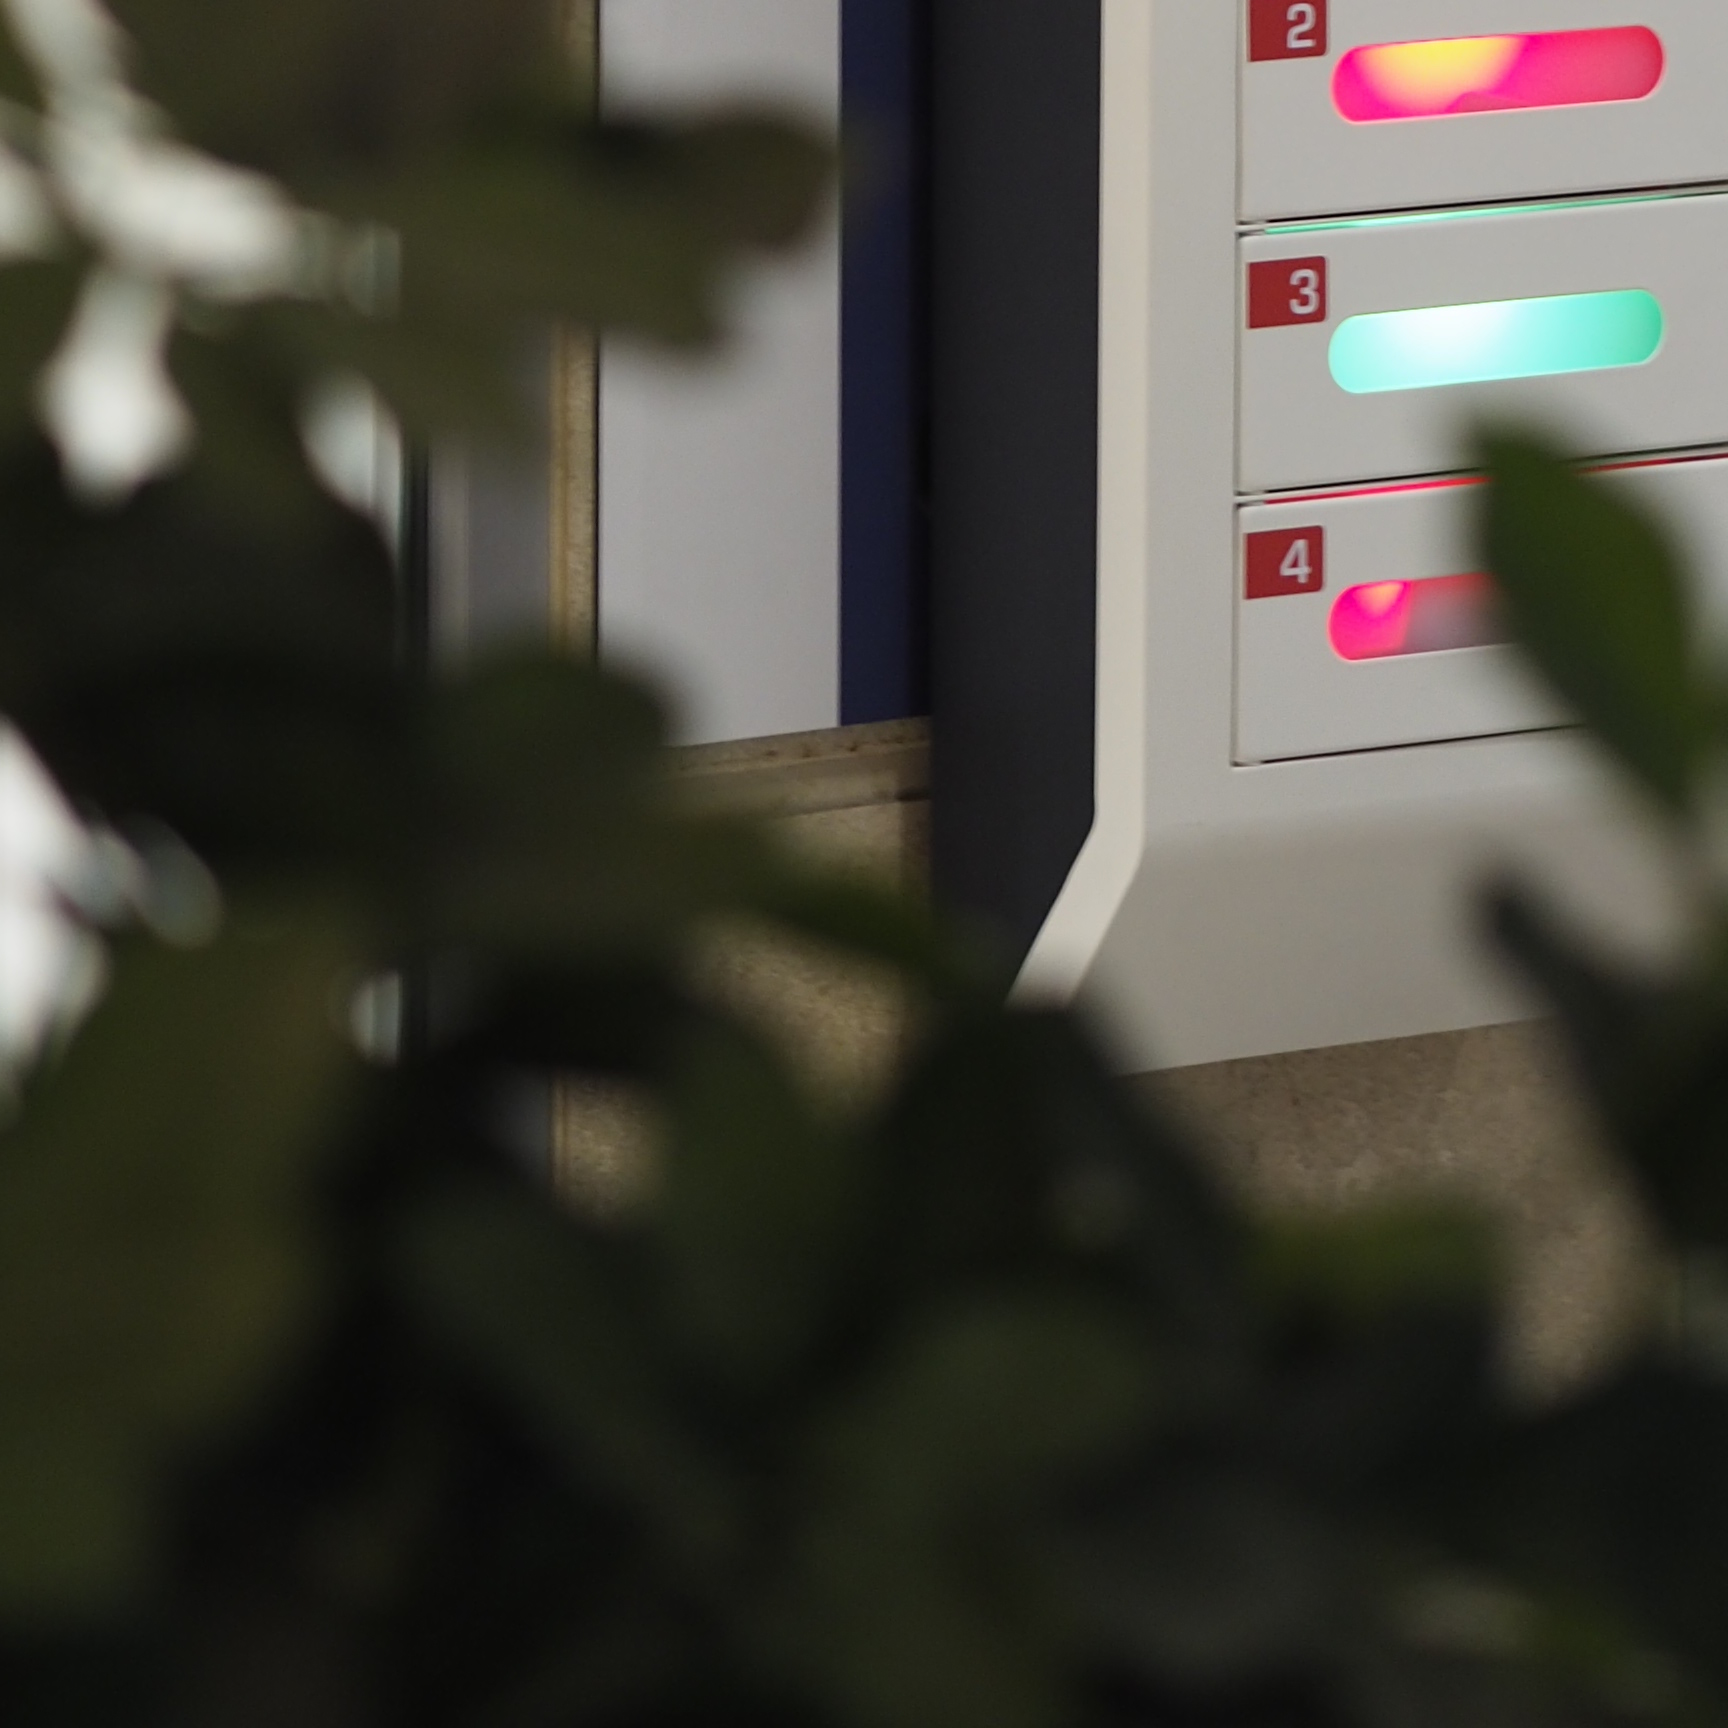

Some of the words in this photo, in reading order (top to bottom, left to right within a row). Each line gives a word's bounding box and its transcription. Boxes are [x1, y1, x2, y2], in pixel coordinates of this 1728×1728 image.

[1286, 2, 1317, 49] 2
[1289, 268, 1320, 315] 3
[1279, 538, 1313, 584] 4
